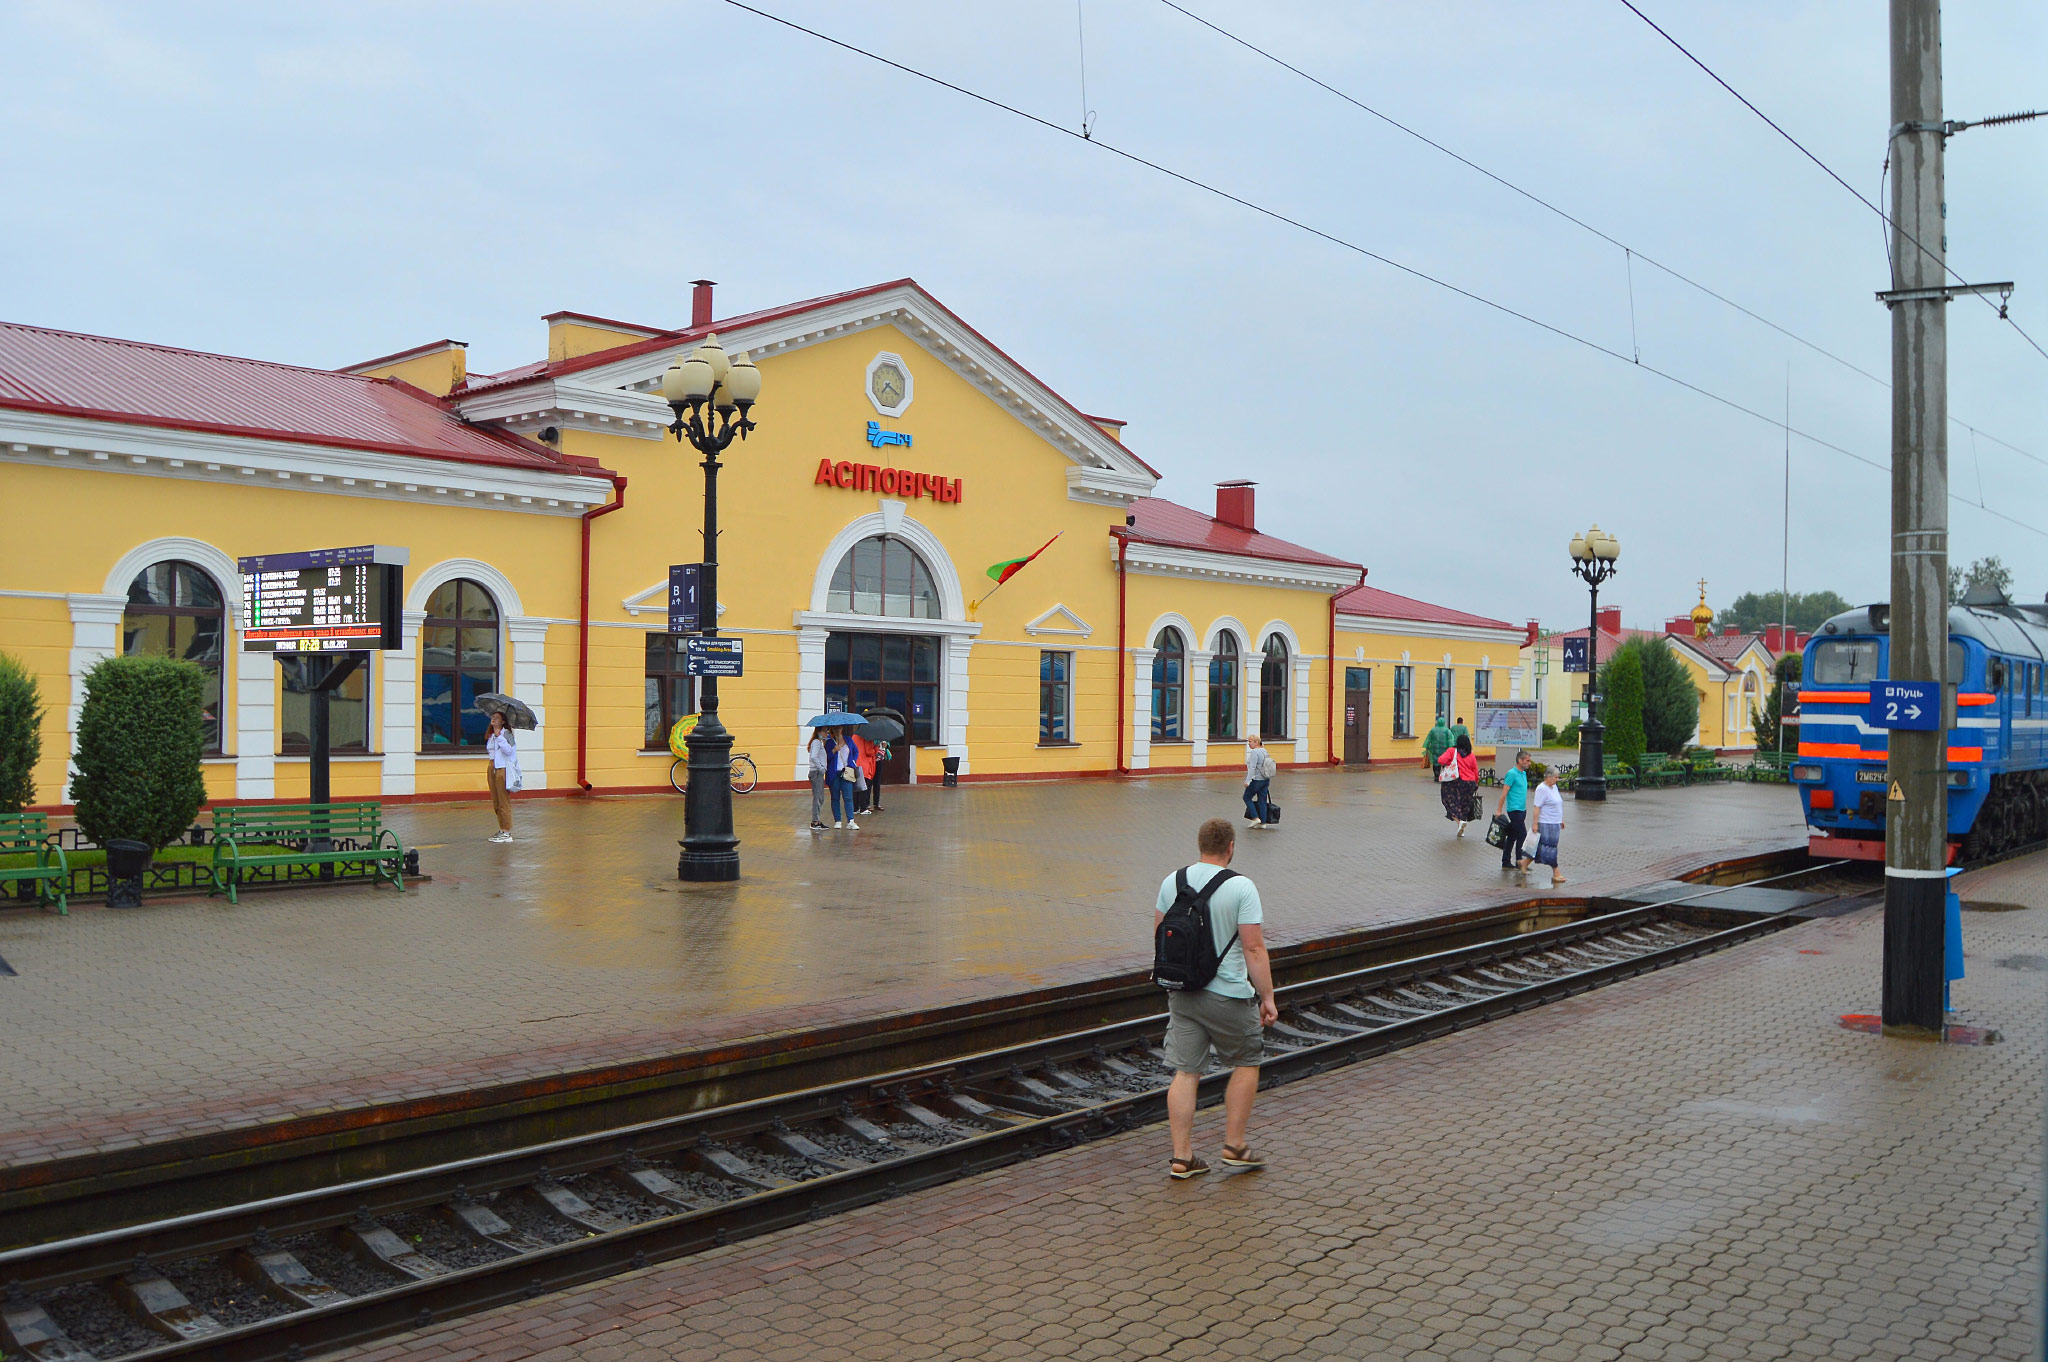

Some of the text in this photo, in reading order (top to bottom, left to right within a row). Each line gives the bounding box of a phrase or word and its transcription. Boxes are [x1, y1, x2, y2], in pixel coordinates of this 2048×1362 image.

[815, 458, 962, 504] АСІПОВІЧЫ
[673, 585, 680, 596] B
[688, 585, 695, 603] 1
[1565, 648, 1573, 658] A
[1578, 648, 1583, 658] 1
[1896, 687, 1924, 699] Пуць
[1885, 702, 1898, 720] 2
